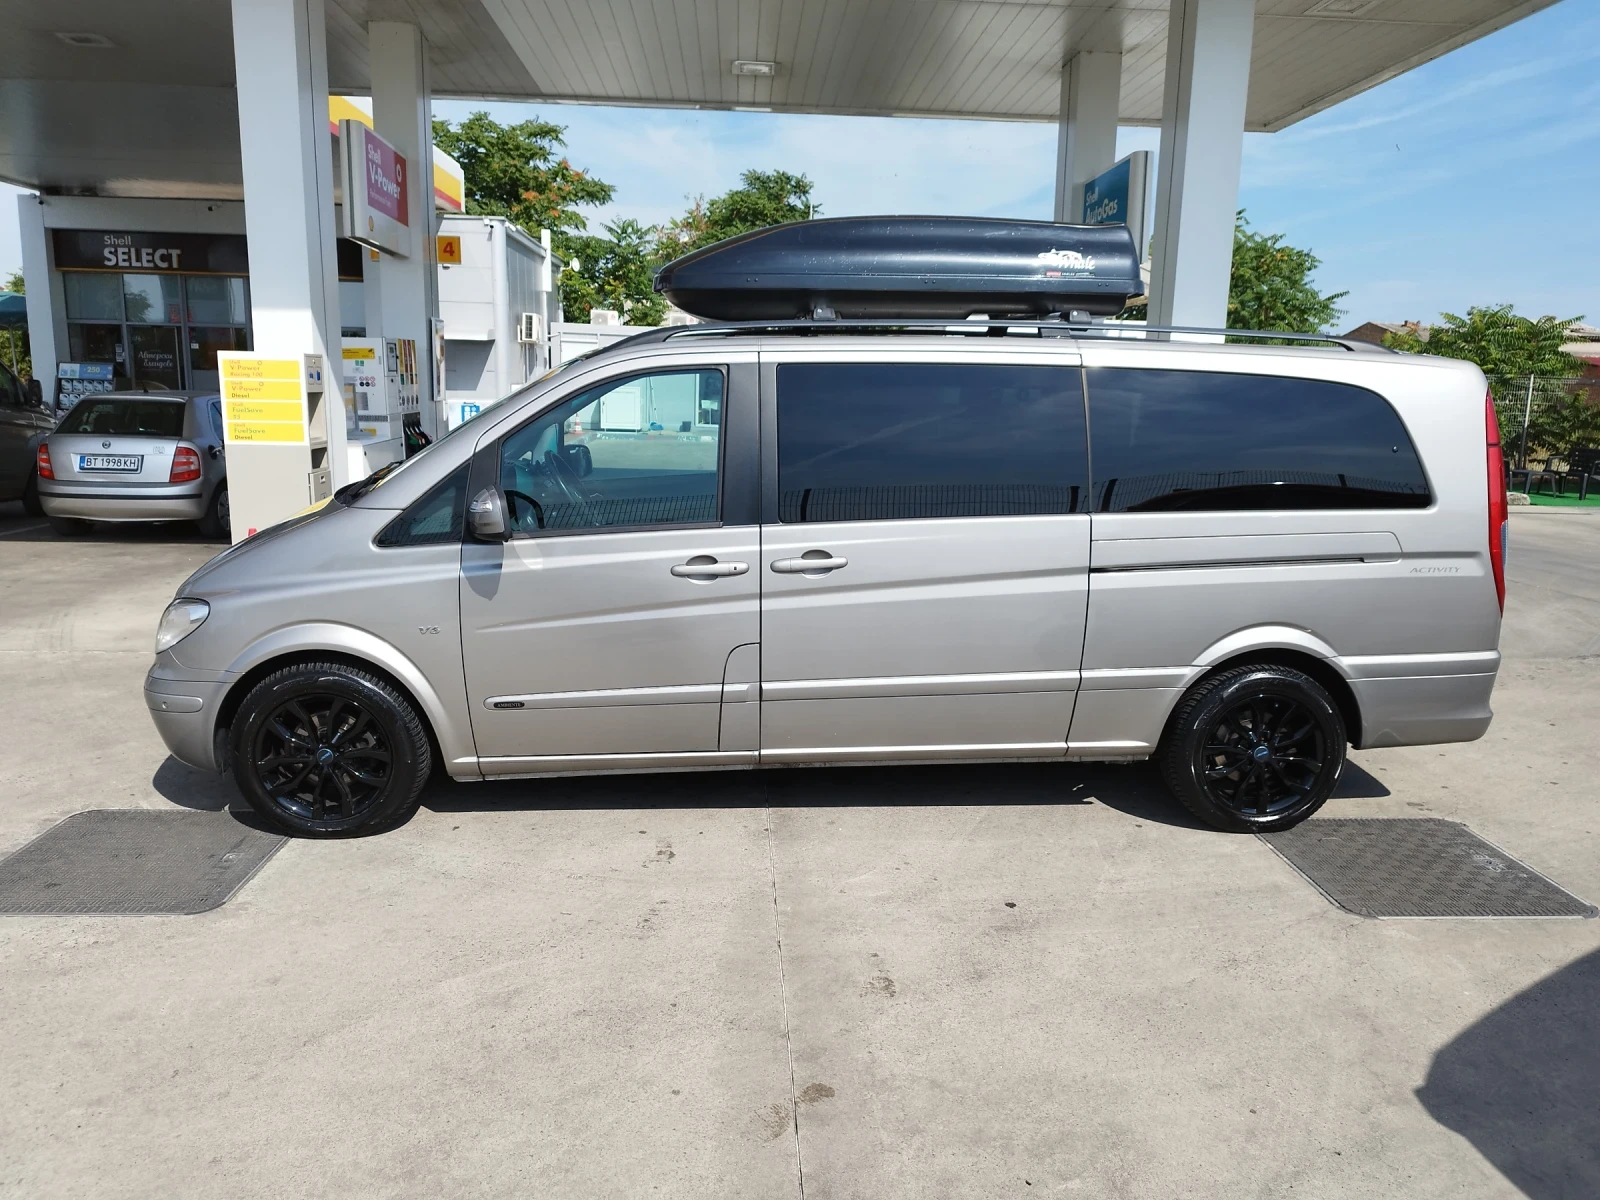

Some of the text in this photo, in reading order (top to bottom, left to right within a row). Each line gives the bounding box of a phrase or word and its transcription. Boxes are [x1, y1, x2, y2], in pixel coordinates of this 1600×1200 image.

[368, 143, 381, 165] Shell
[369, 161, 400, 199] V-Power
[1086, 186, 1099, 206] Shell
[1085, 198, 1118, 224] AutoGas
[103, 235, 132, 245] Shell
[443, 241, 455, 257] 4
[103, 247, 181, 269] SELECT
[86, 457, 137, 468] BT 1998 KH
